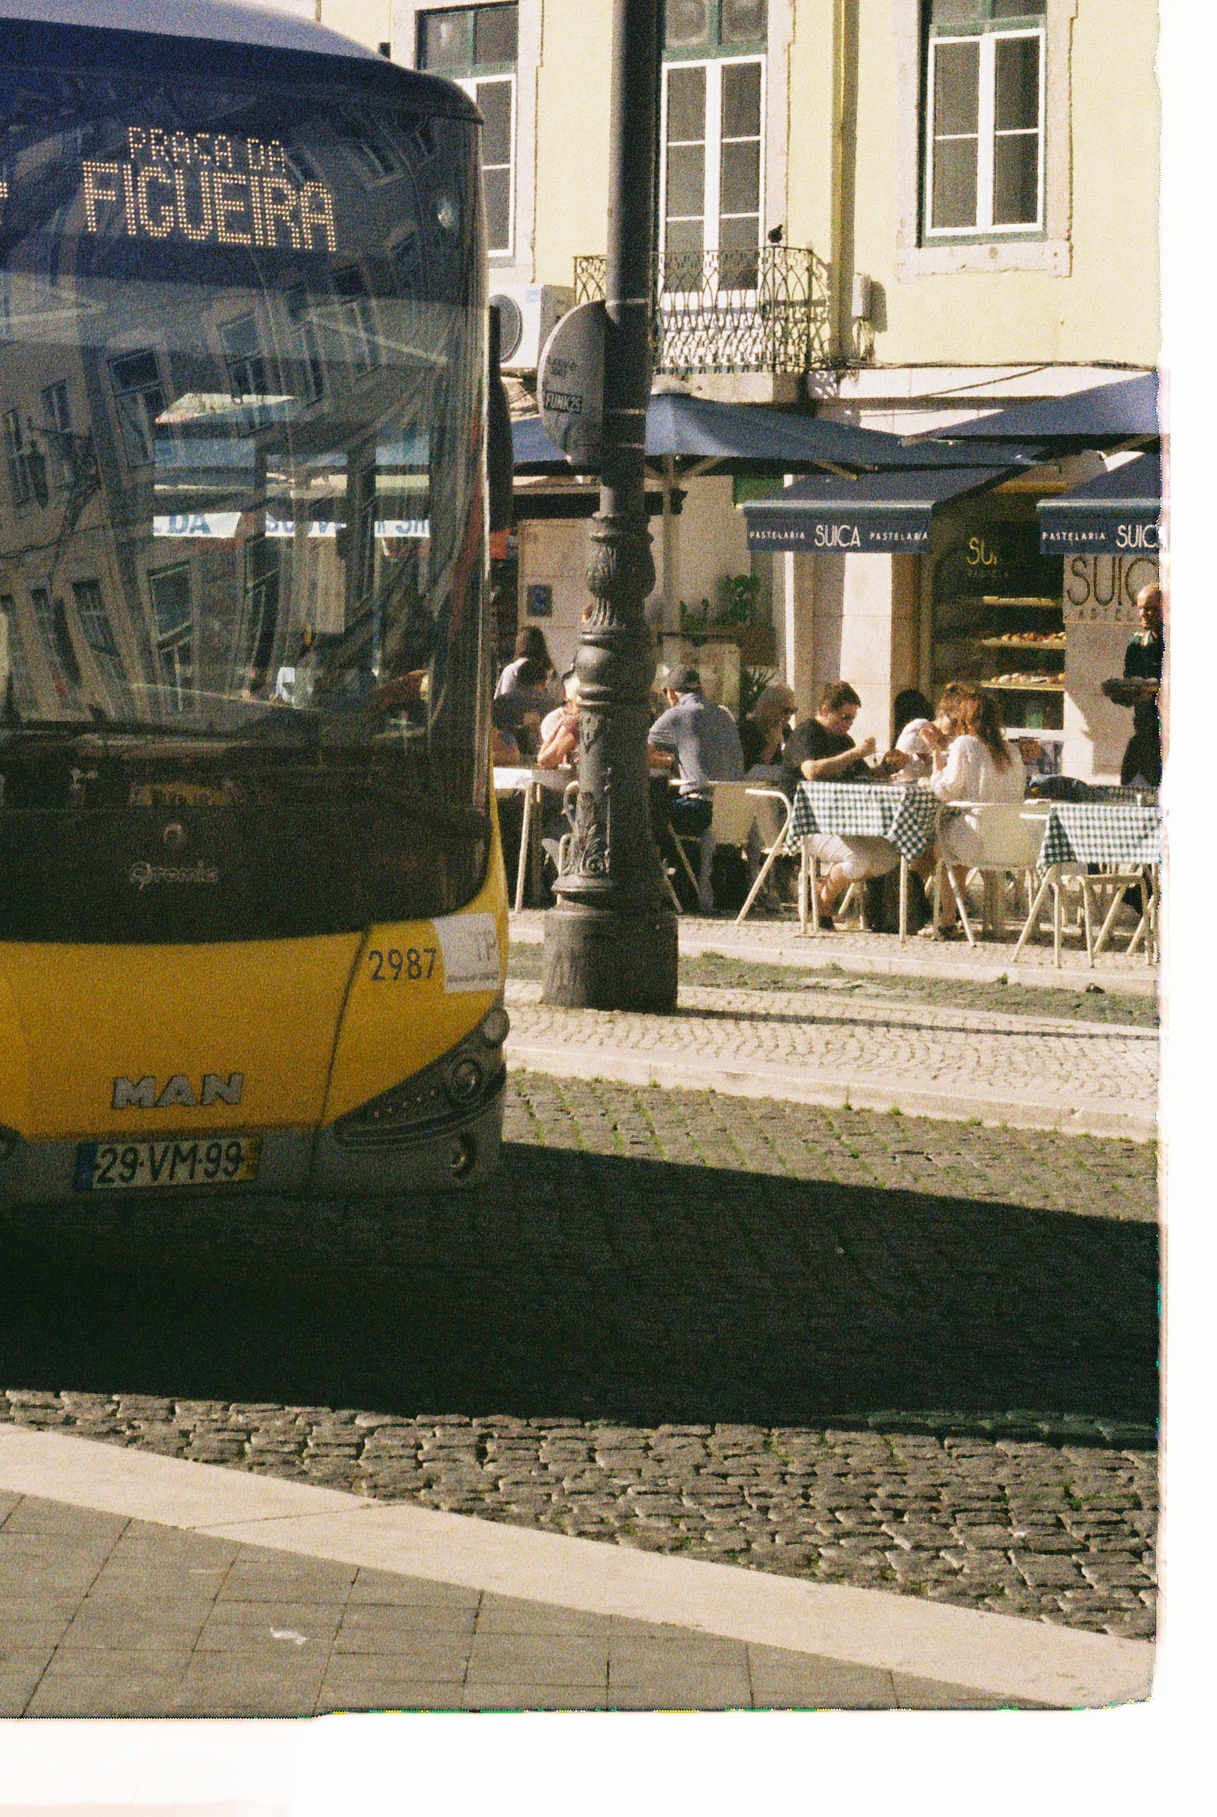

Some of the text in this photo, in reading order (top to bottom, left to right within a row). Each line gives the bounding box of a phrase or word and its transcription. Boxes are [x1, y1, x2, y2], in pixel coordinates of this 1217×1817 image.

[127, 125, 285, 175] PRAÇA DA
[81, 160, 337, 252] FIGUEIRA
[749, 530, 805, 540] PASTELARIA
[869, 531, 929, 541] PASTELARIA
[1042, 531, 1106, 541] PASTELARIA
[368, 947, 438, 982] 2987
[111, 1072, 245, 1110] MAN
